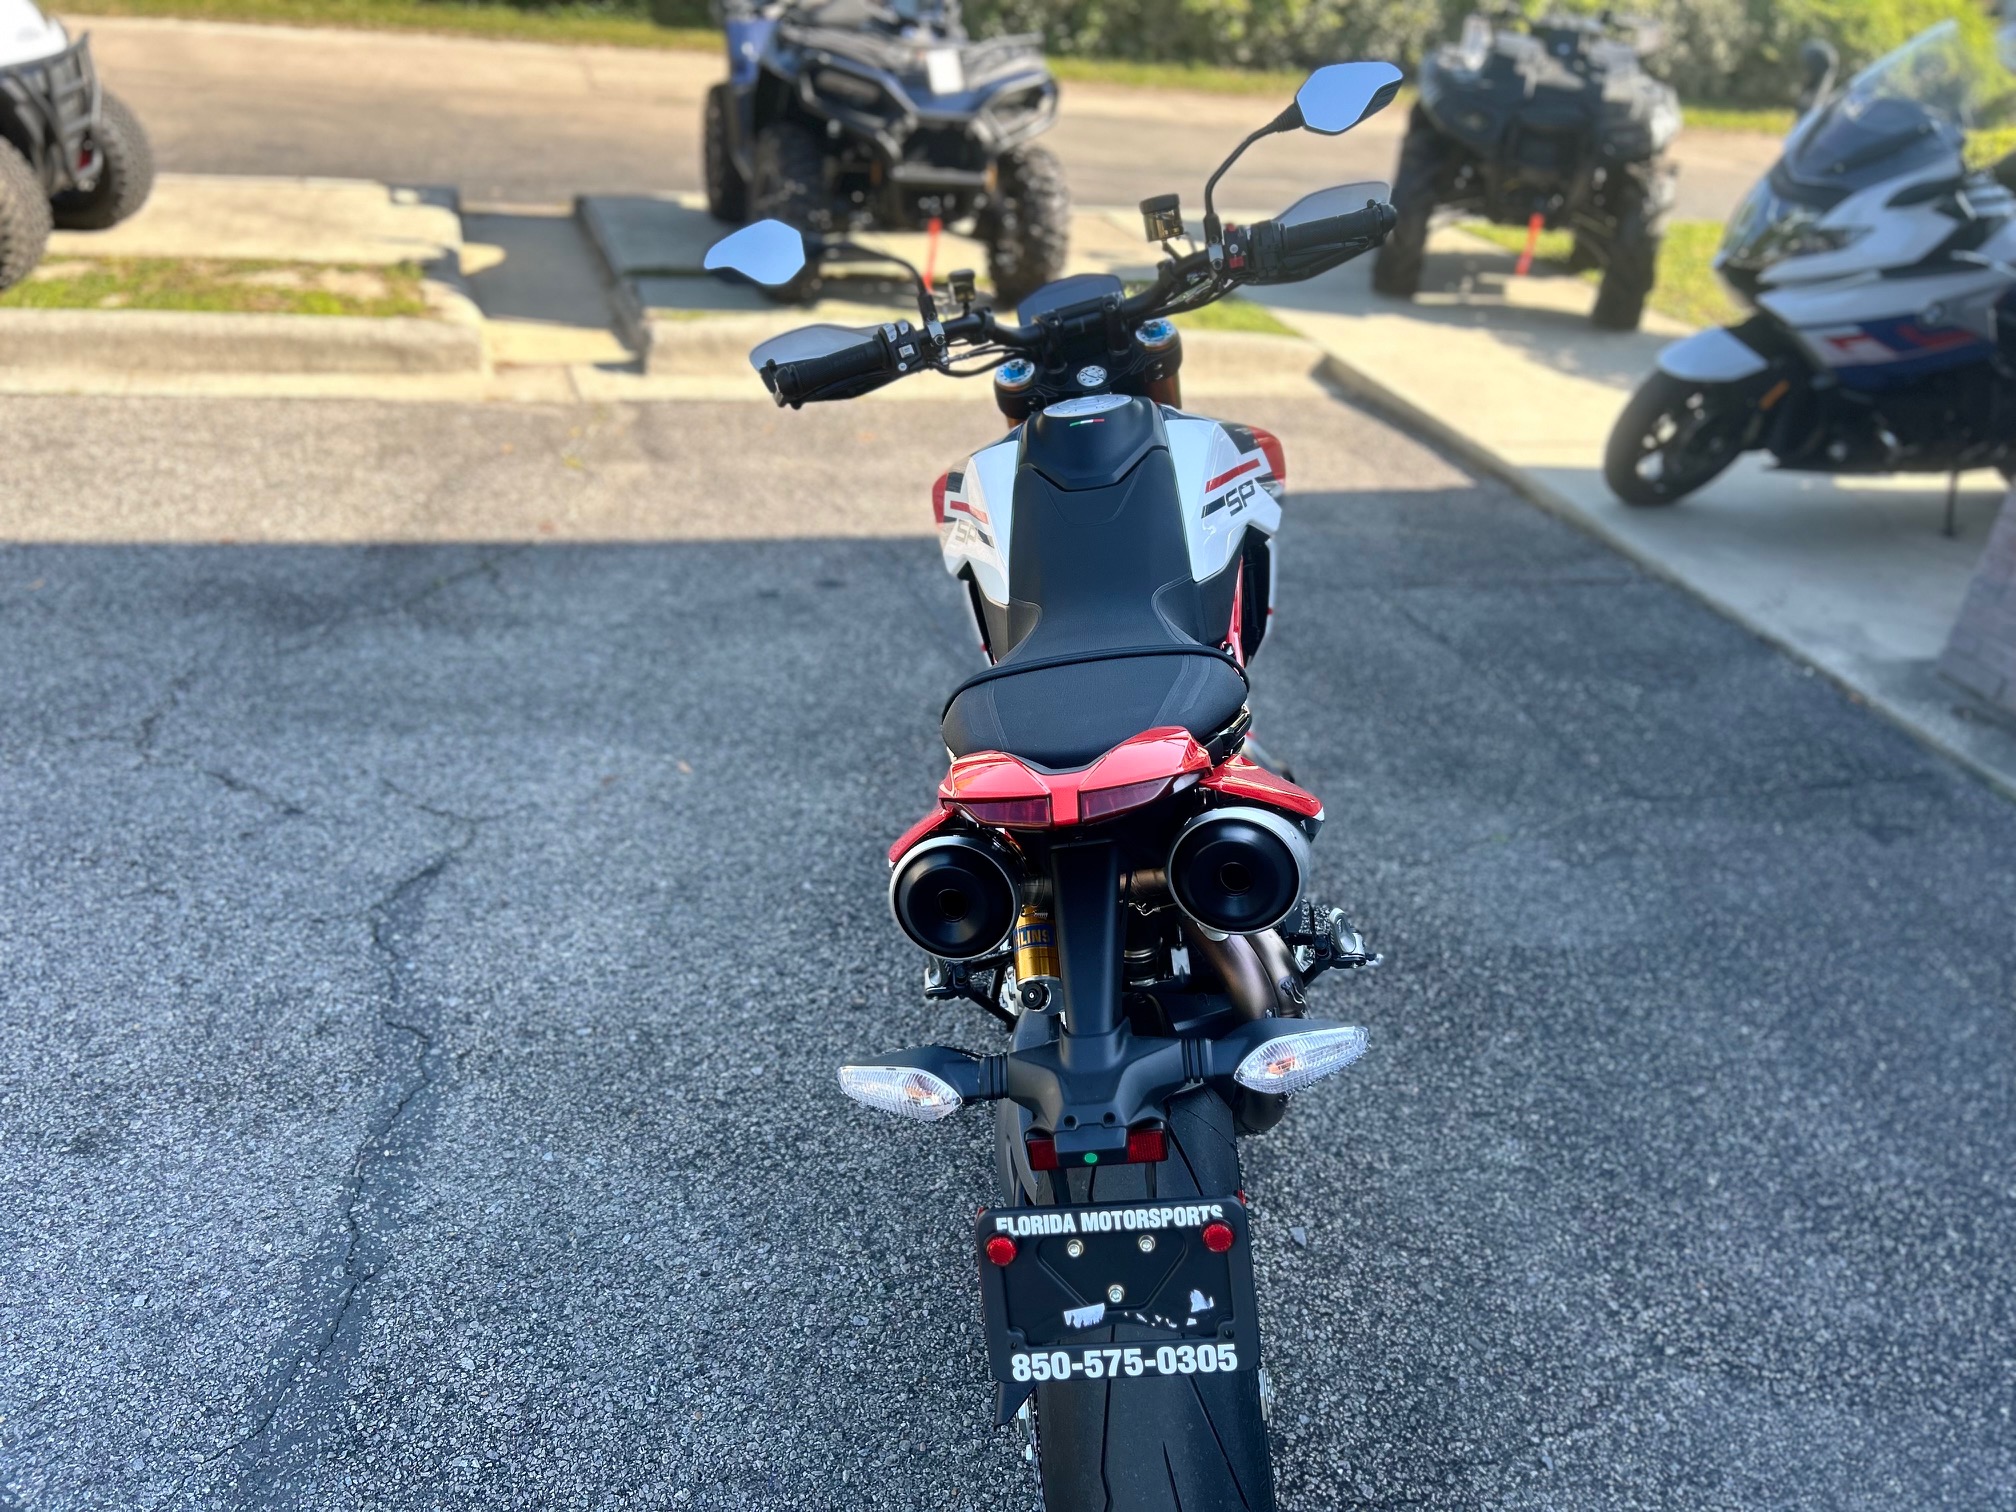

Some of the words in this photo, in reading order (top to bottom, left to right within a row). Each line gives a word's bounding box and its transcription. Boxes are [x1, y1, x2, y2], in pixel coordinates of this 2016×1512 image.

[1226, 480, 1255, 517] SP
[996, 1213, 1077, 1236] FLORIDA
[1081, 1204, 1223, 1232] MOTORSPORTS
[1011, 1343, 1238, 1381] 850-575-0305
